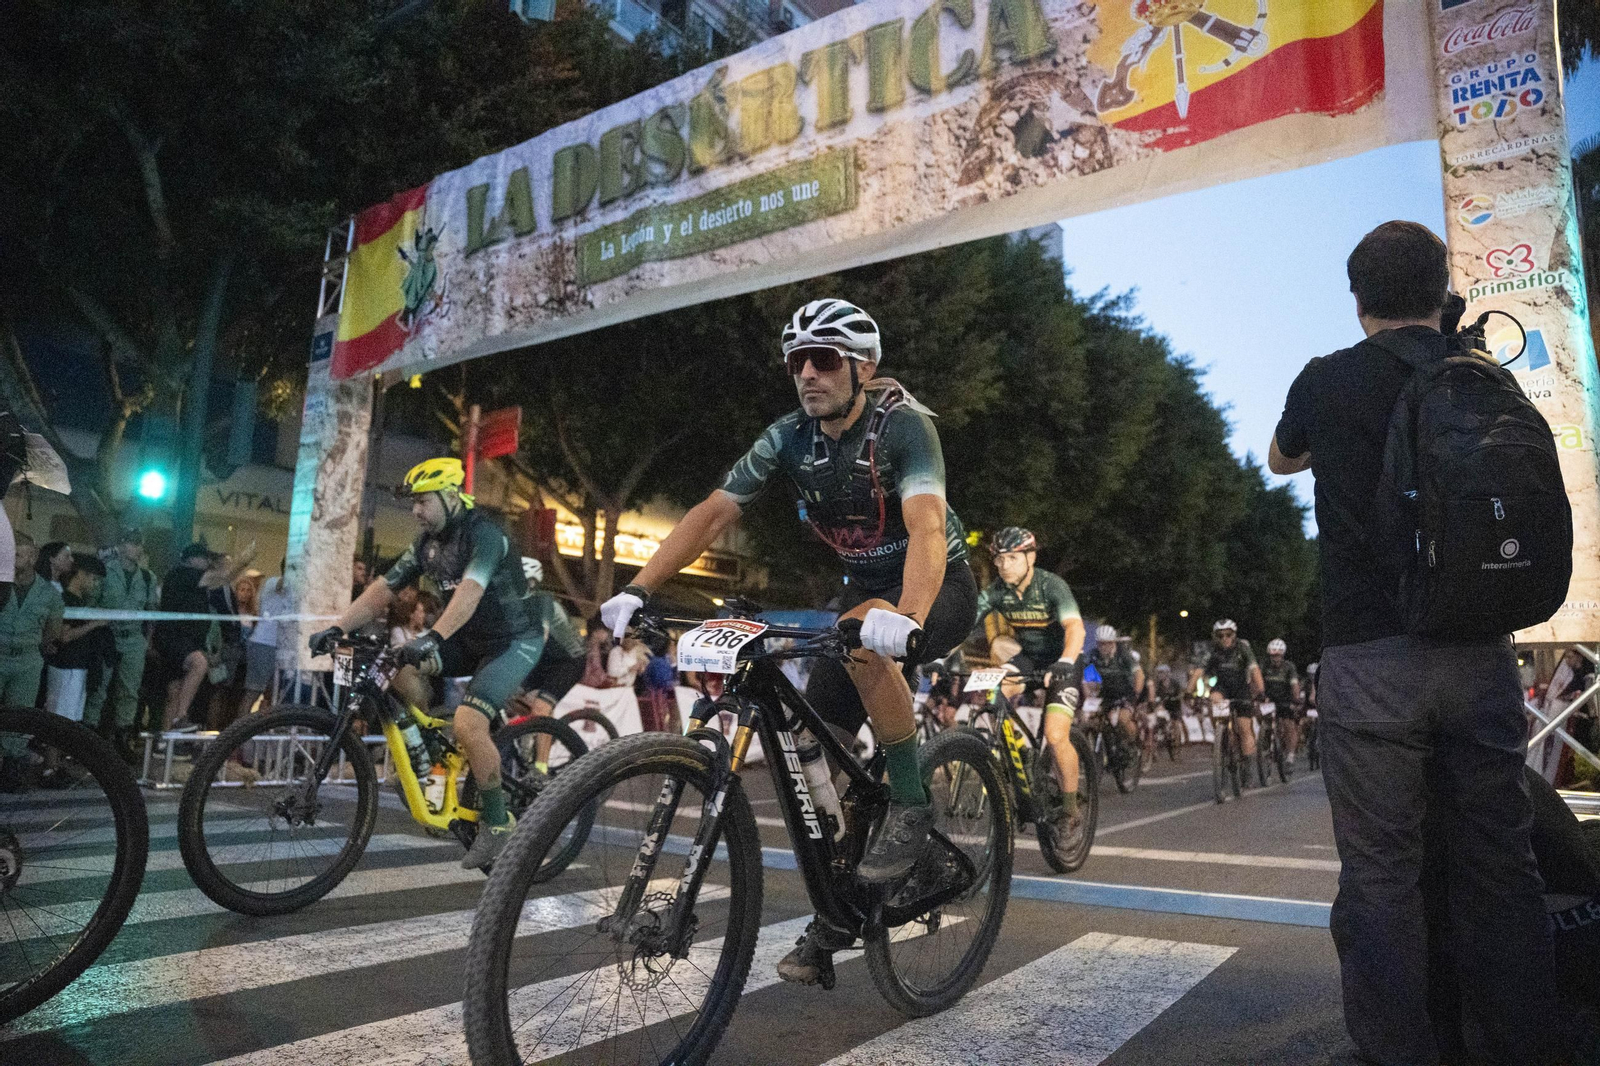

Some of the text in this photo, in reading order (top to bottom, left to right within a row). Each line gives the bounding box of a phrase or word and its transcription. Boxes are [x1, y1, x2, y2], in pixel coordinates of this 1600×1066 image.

[1451, 53, 1537, 85] GRUPO
[1452, 67, 1542, 105] RENTA
[1453, 88, 1544, 126] TODO
[464, 164, 538, 259] LA
[600, 240, 615, 261] La
[663, 223, 673, 244] y
[680, 213, 693, 237] el
[700, 200, 753, 232] desierto
[759, 189, 785, 213] nos
[792, 179, 820, 201] une
[1468, 271, 1566, 303] primaflor
[691, 628, 750, 649] 7286
[776, 731, 823, 839] BERRIA
